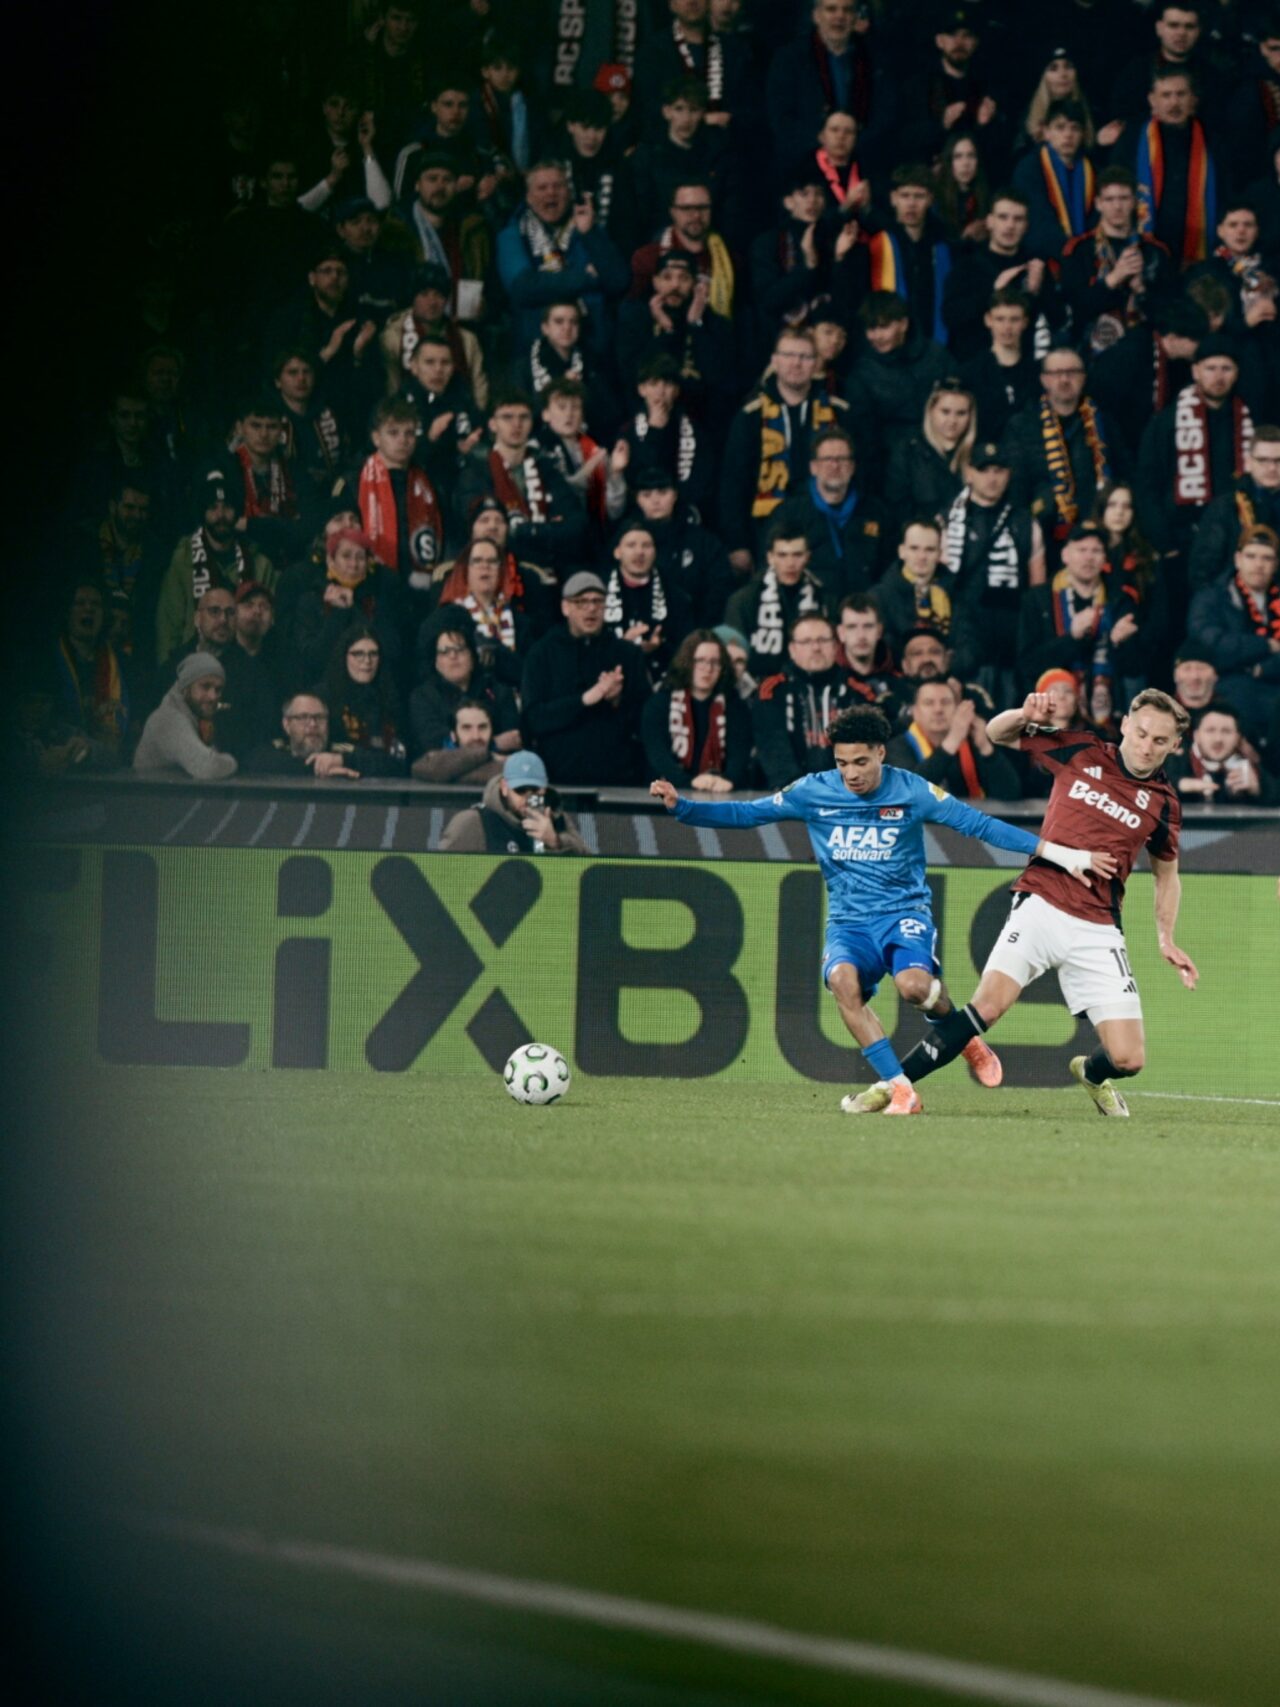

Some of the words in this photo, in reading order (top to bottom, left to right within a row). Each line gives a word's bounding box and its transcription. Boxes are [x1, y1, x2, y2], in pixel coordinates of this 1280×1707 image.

[1067, 779, 1142, 830] Betano
[1134, 789, 1150, 811] S
[826, 825, 900, 849] AFAS
[832, 847, 892, 861] software
